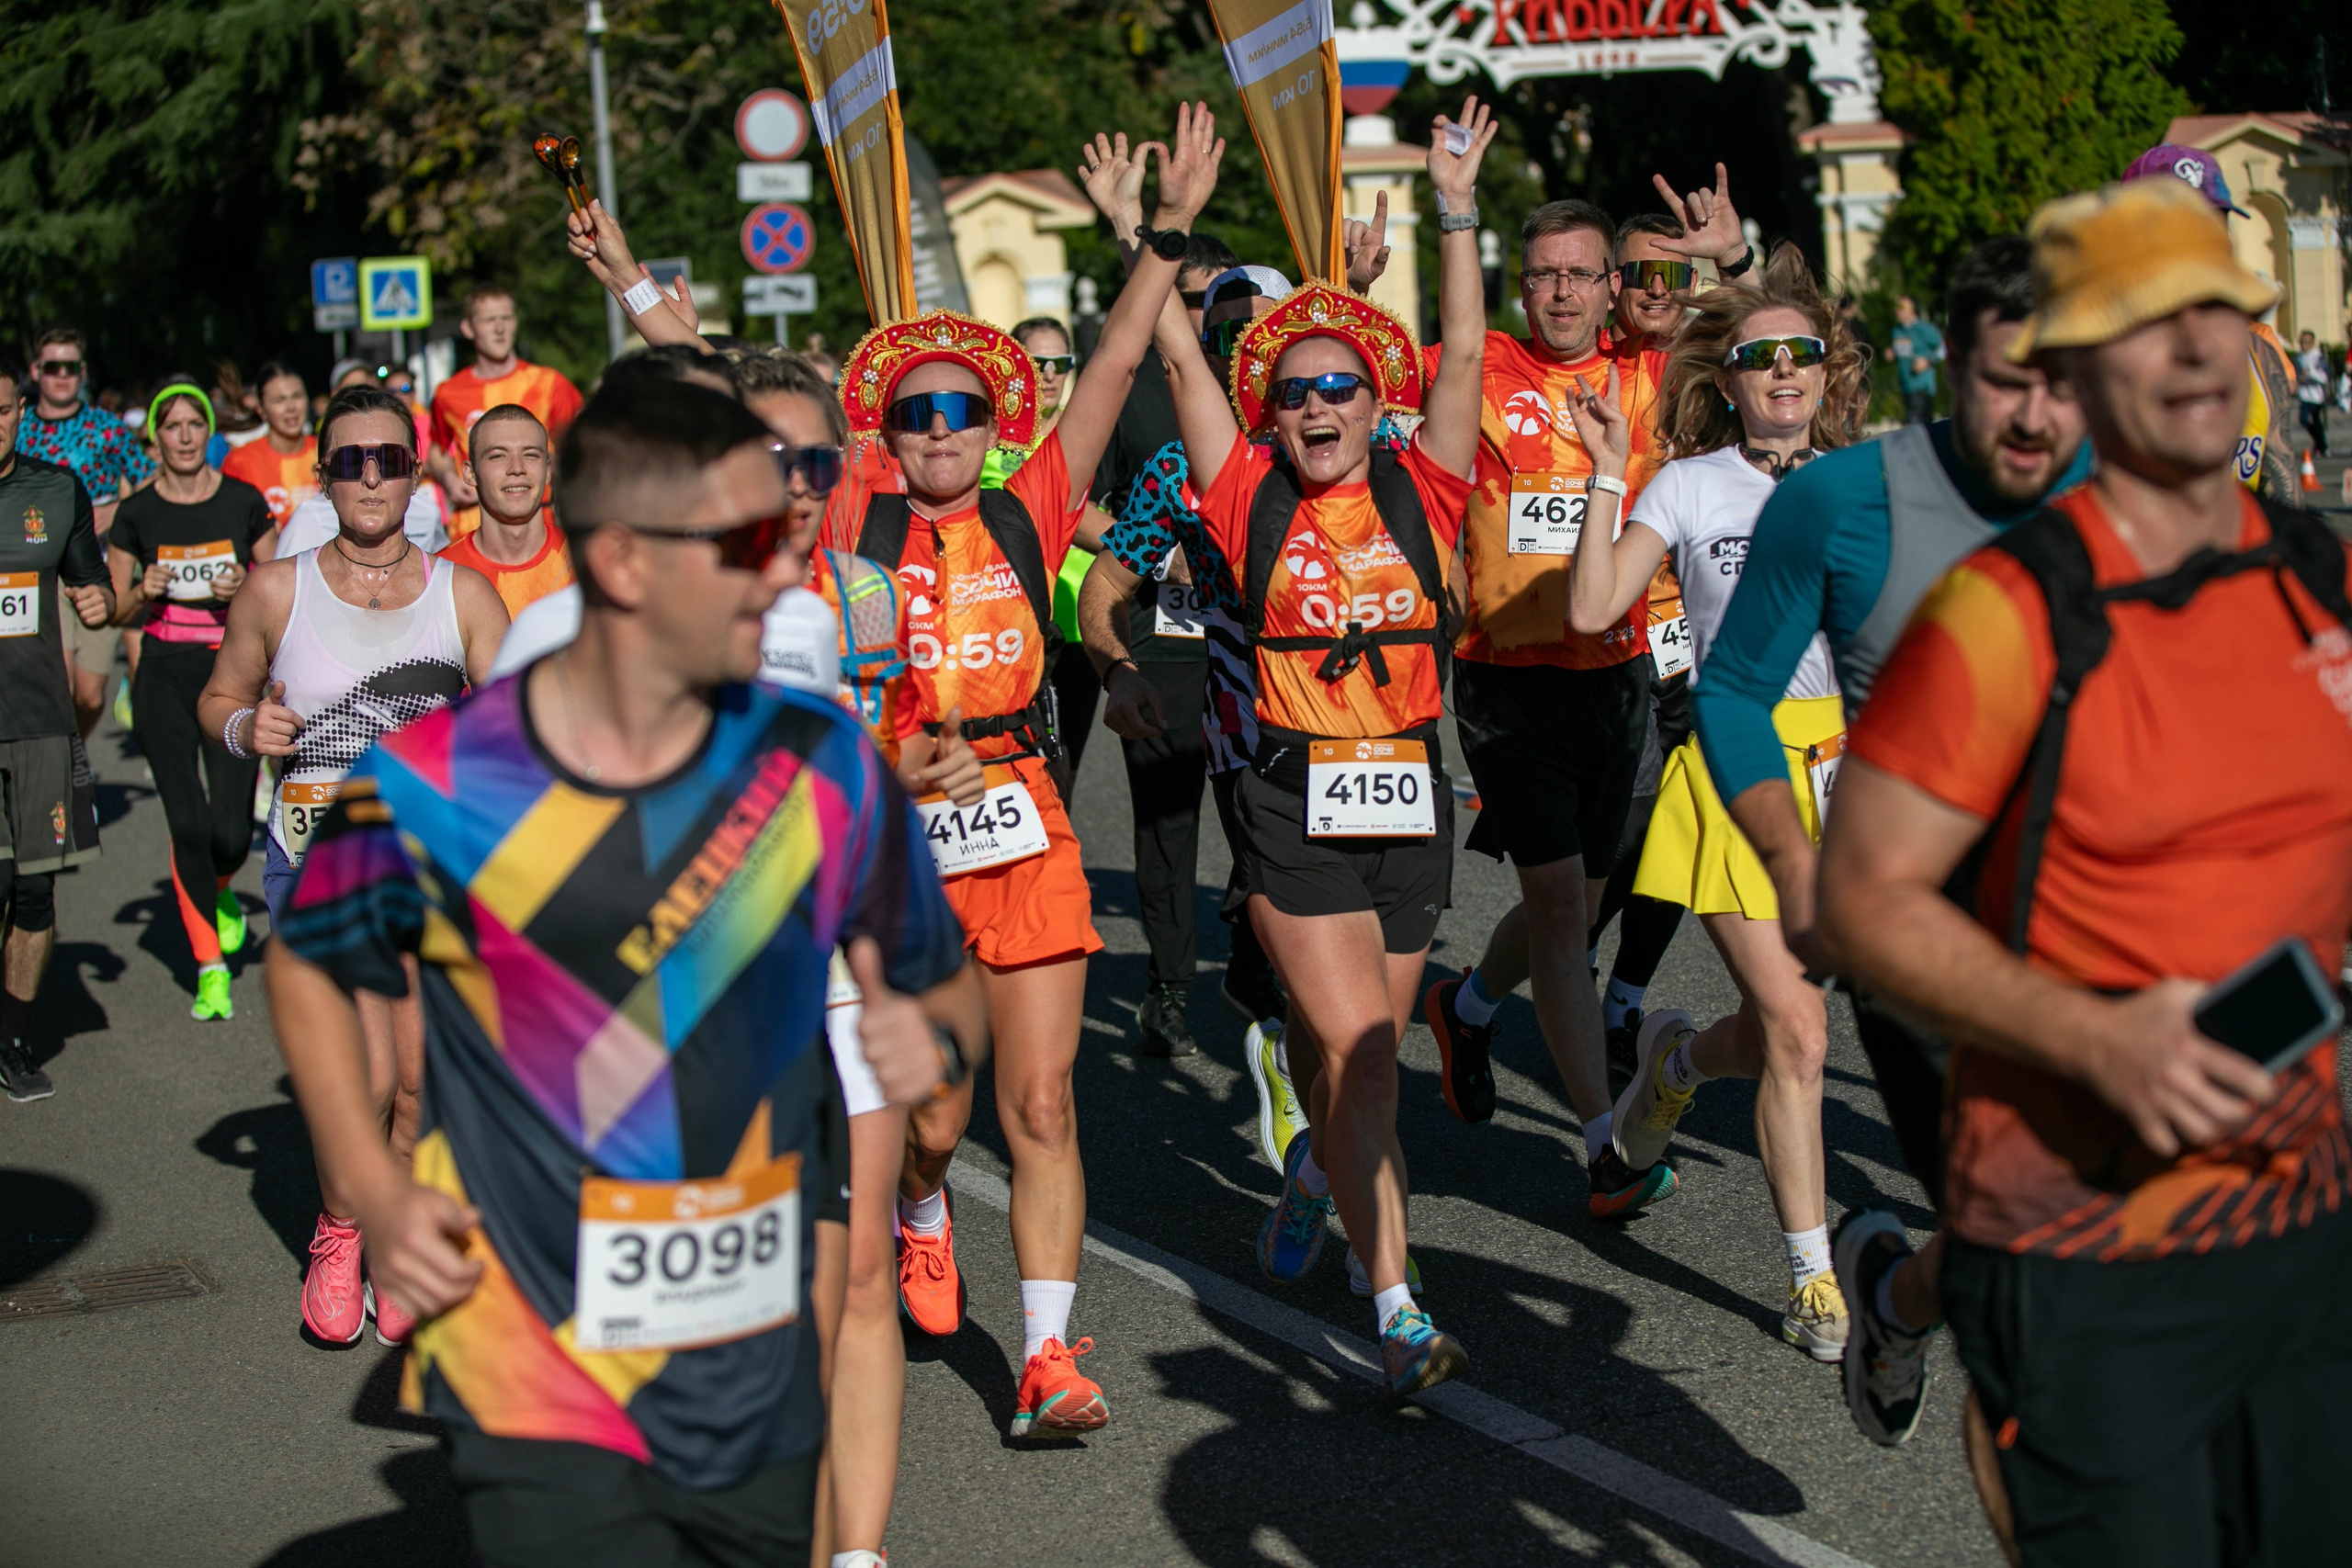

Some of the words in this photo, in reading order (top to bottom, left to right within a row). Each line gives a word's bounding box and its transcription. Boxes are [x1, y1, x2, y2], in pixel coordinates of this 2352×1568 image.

[1520, 542, 1527, 551] D
[950, 586, 1022, 606] МАРАФОН
[1296, 582, 1328, 592] 10КМ
[1, 594, 27, 616] 61
[1301, 588, 1415, 631] 0:59
[907, 621, 934, 631] 0КМ
[908, 628, 1024, 671] 0:59
[1325, 773, 1418, 805] 4150
[926, 795, 1022, 844] 4145
[959, 836, 1001, 856] ИННА
[607, 1209, 783, 1287] 3098
